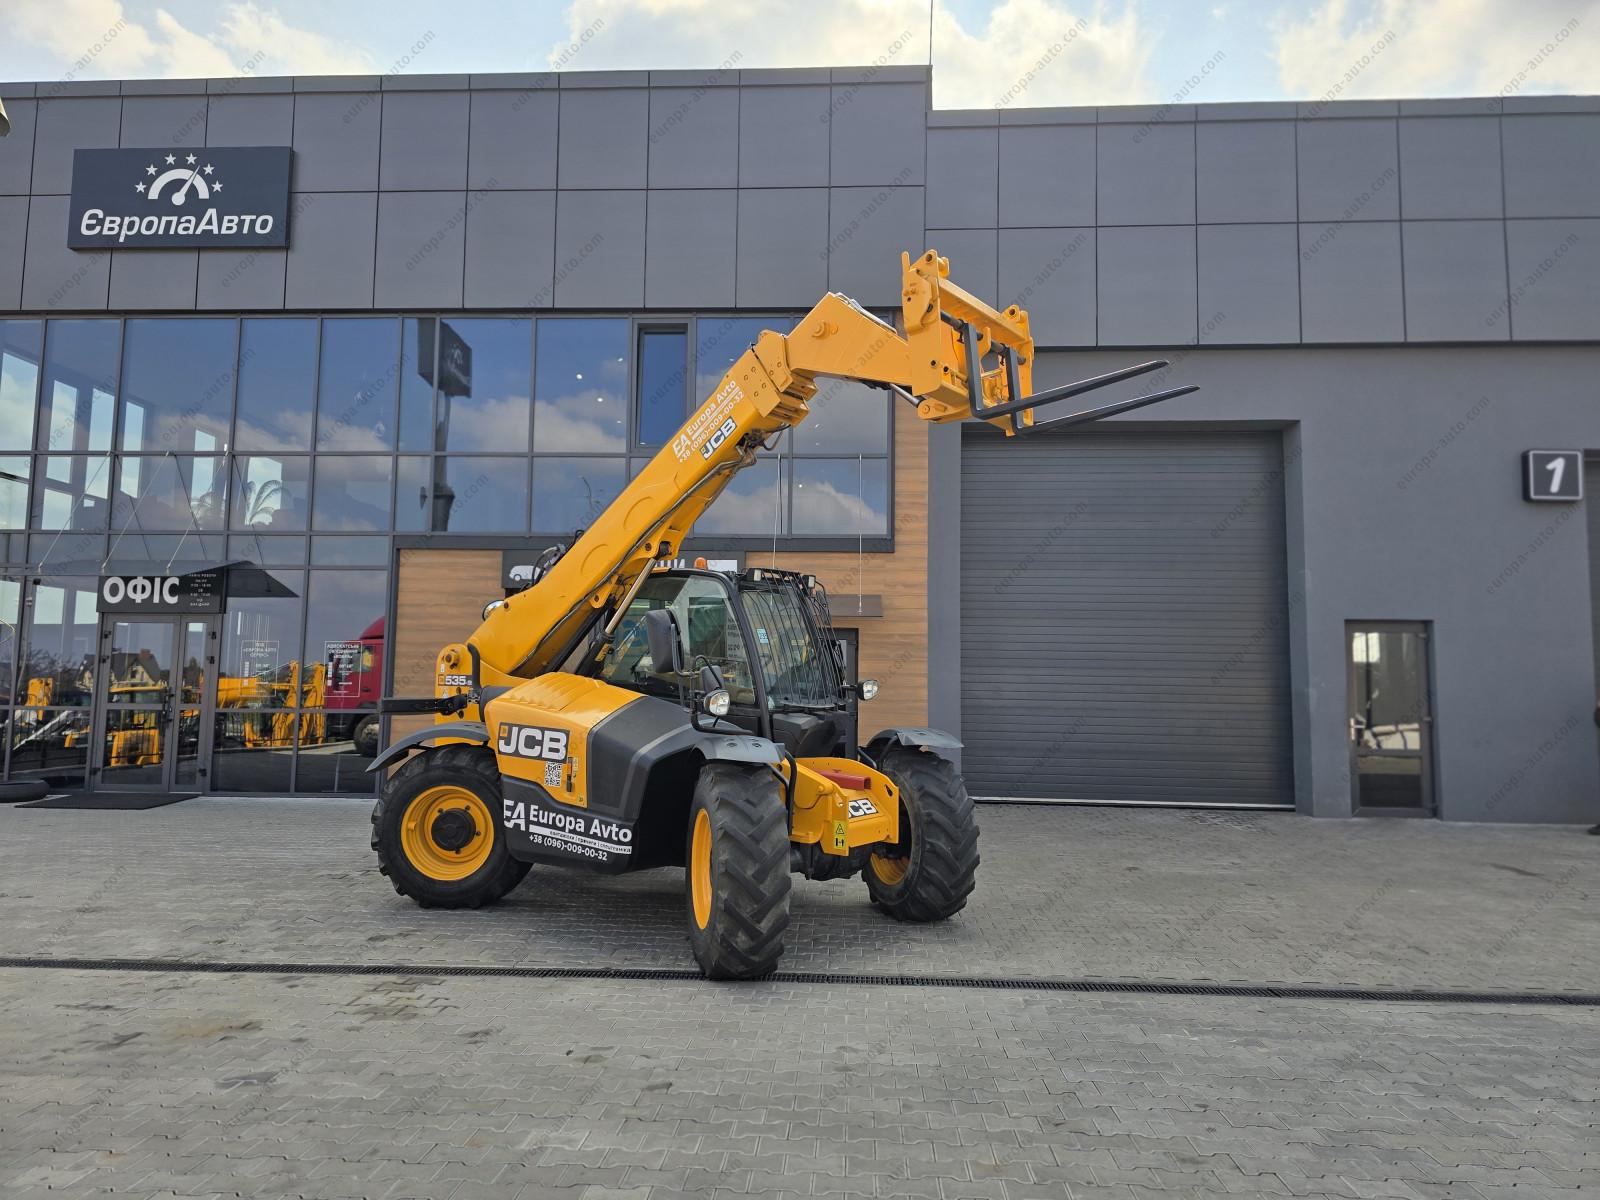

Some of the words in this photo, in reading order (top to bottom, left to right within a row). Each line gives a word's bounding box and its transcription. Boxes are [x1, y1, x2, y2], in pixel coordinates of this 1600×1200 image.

[80, 208, 273, 243] ЄвропаАвто
[686, 402, 717, 436] Europa
[716, 380, 736, 404] Avto
[702, 417, 737, 459] JCB
[1545, 457, 1565, 493] 1
[103, 576, 180, 604] ОФІС
[499, 726, 568, 761] JCB
[529, 804, 585, 833] Europa
[590, 819, 632, 843] Avto
[848, 799, 878, 818] CB
[529, 835, 542, 844] +38
[543, 837, 608, 861] (096)-009-00-32
